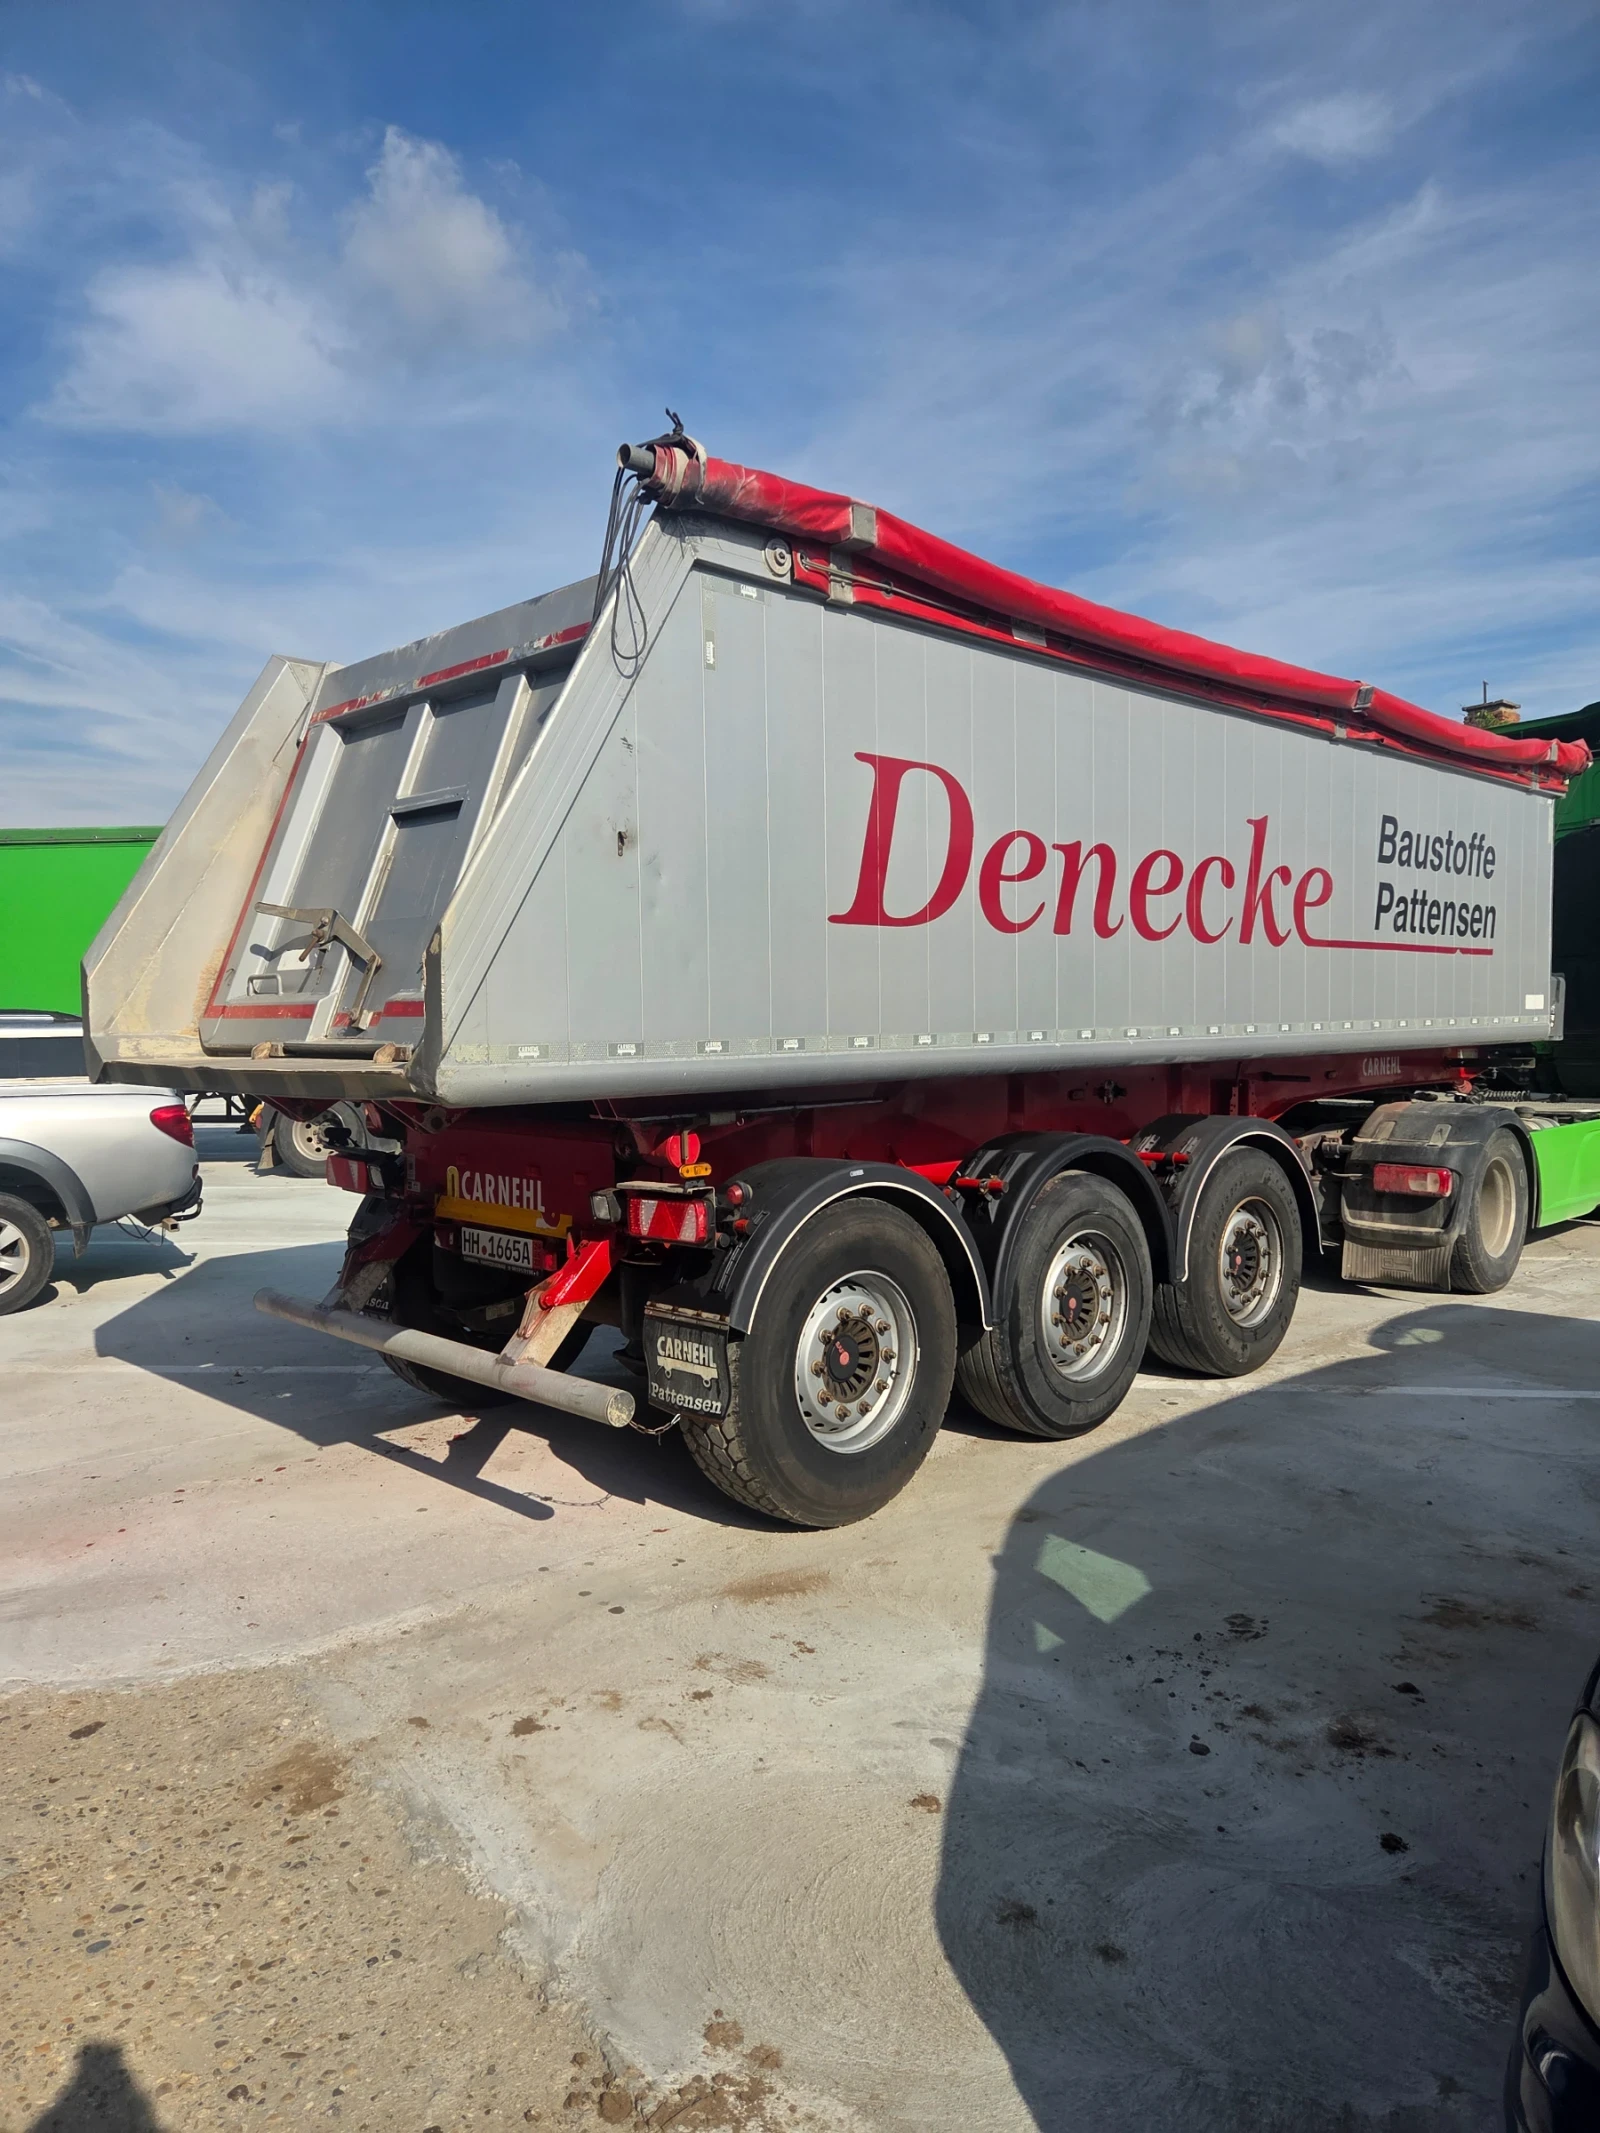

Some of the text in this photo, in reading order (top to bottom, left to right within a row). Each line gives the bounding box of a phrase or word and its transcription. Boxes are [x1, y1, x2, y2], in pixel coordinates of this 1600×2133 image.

[827, 751, 1333, 947] Denecke
[1377, 814, 1496, 880] Baustoffe
[1374, 881, 1496, 939] Pattensen
[1362, 1056, 1401, 1076] CARNEHL
[461, 1170, 545, 1212] CARNEHL
[463, 1230, 480, 1254] HH
[488, 1235, 531, 1265] 1665A
[656, 1335, 717, 1368] CARNEHL
[651, 1381, 722, 1414] Pattensen
